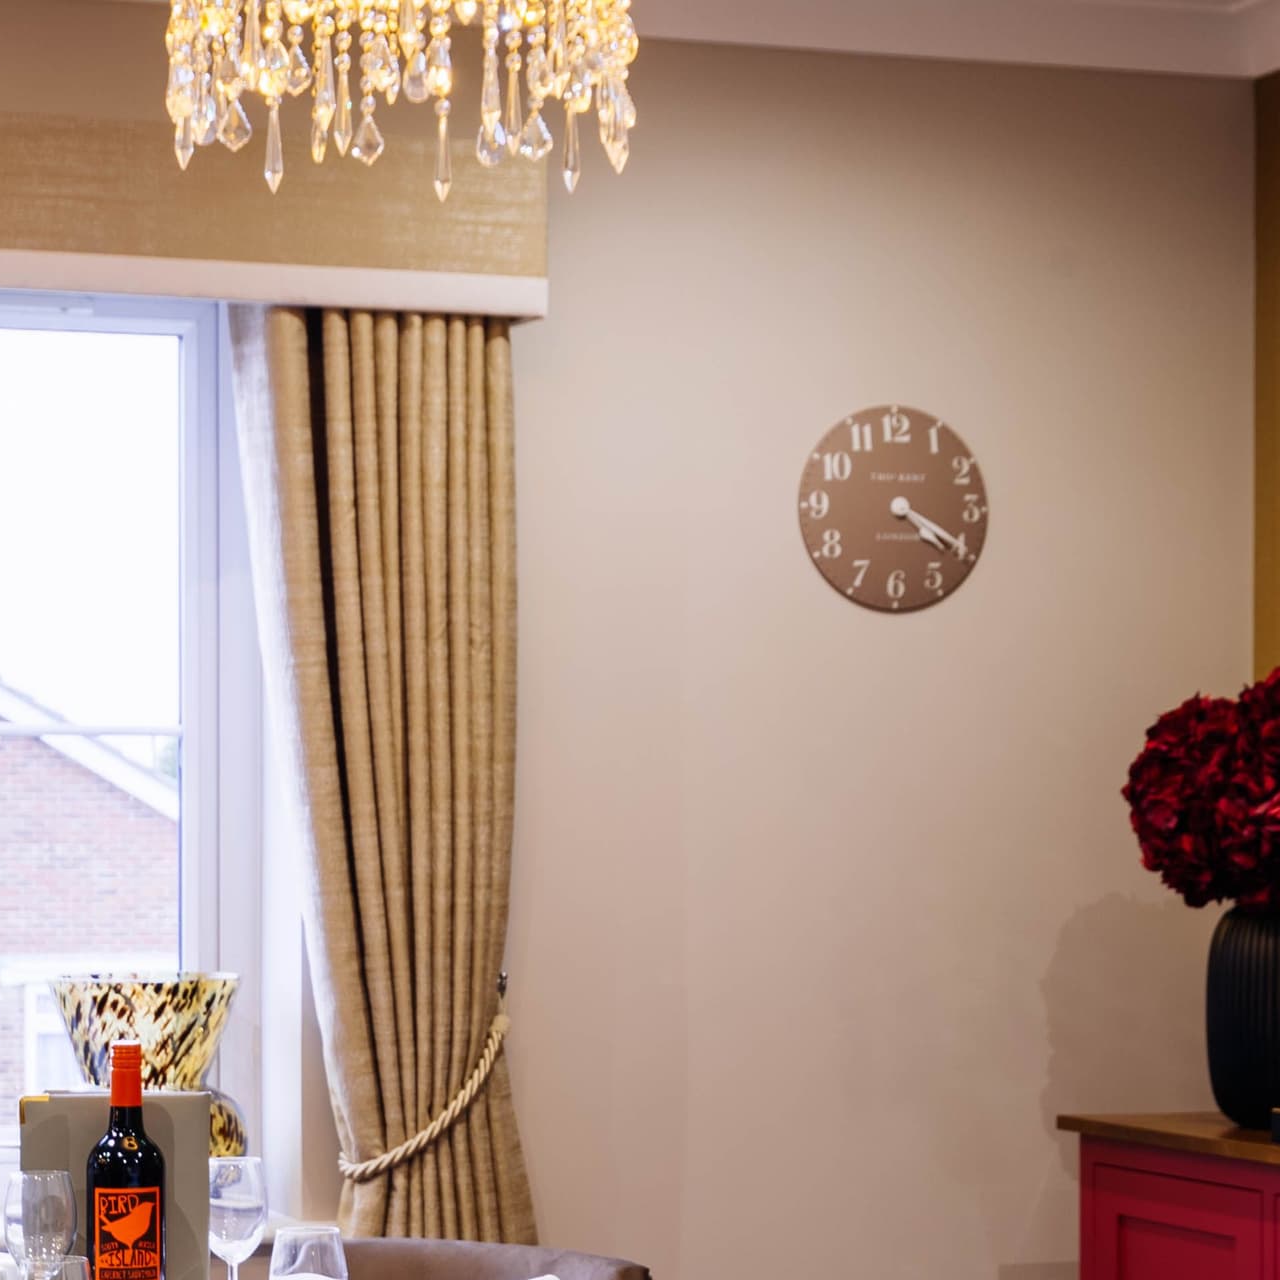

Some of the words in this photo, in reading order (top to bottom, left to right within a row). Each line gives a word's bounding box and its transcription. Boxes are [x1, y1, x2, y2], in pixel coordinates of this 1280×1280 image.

[851, 423, 872, 451] 11
[882, 413, 911, 443] 12
[928, 426, 939, 454] 1
[823, 452, 852, 481] 10
[952, 455, 970, 485] 2
[808, 490, 830, 519] 9
[962, 494, 981, 523] 3
[822, 528, 842, 558] 8
[950, 532, 968, 560] 4
[852, 559, 871, 588] 7
[886, 569, 906, 599] 6
[924, 561, 943, 589] 5
[100, 1194, 140, 1215] BIRD
